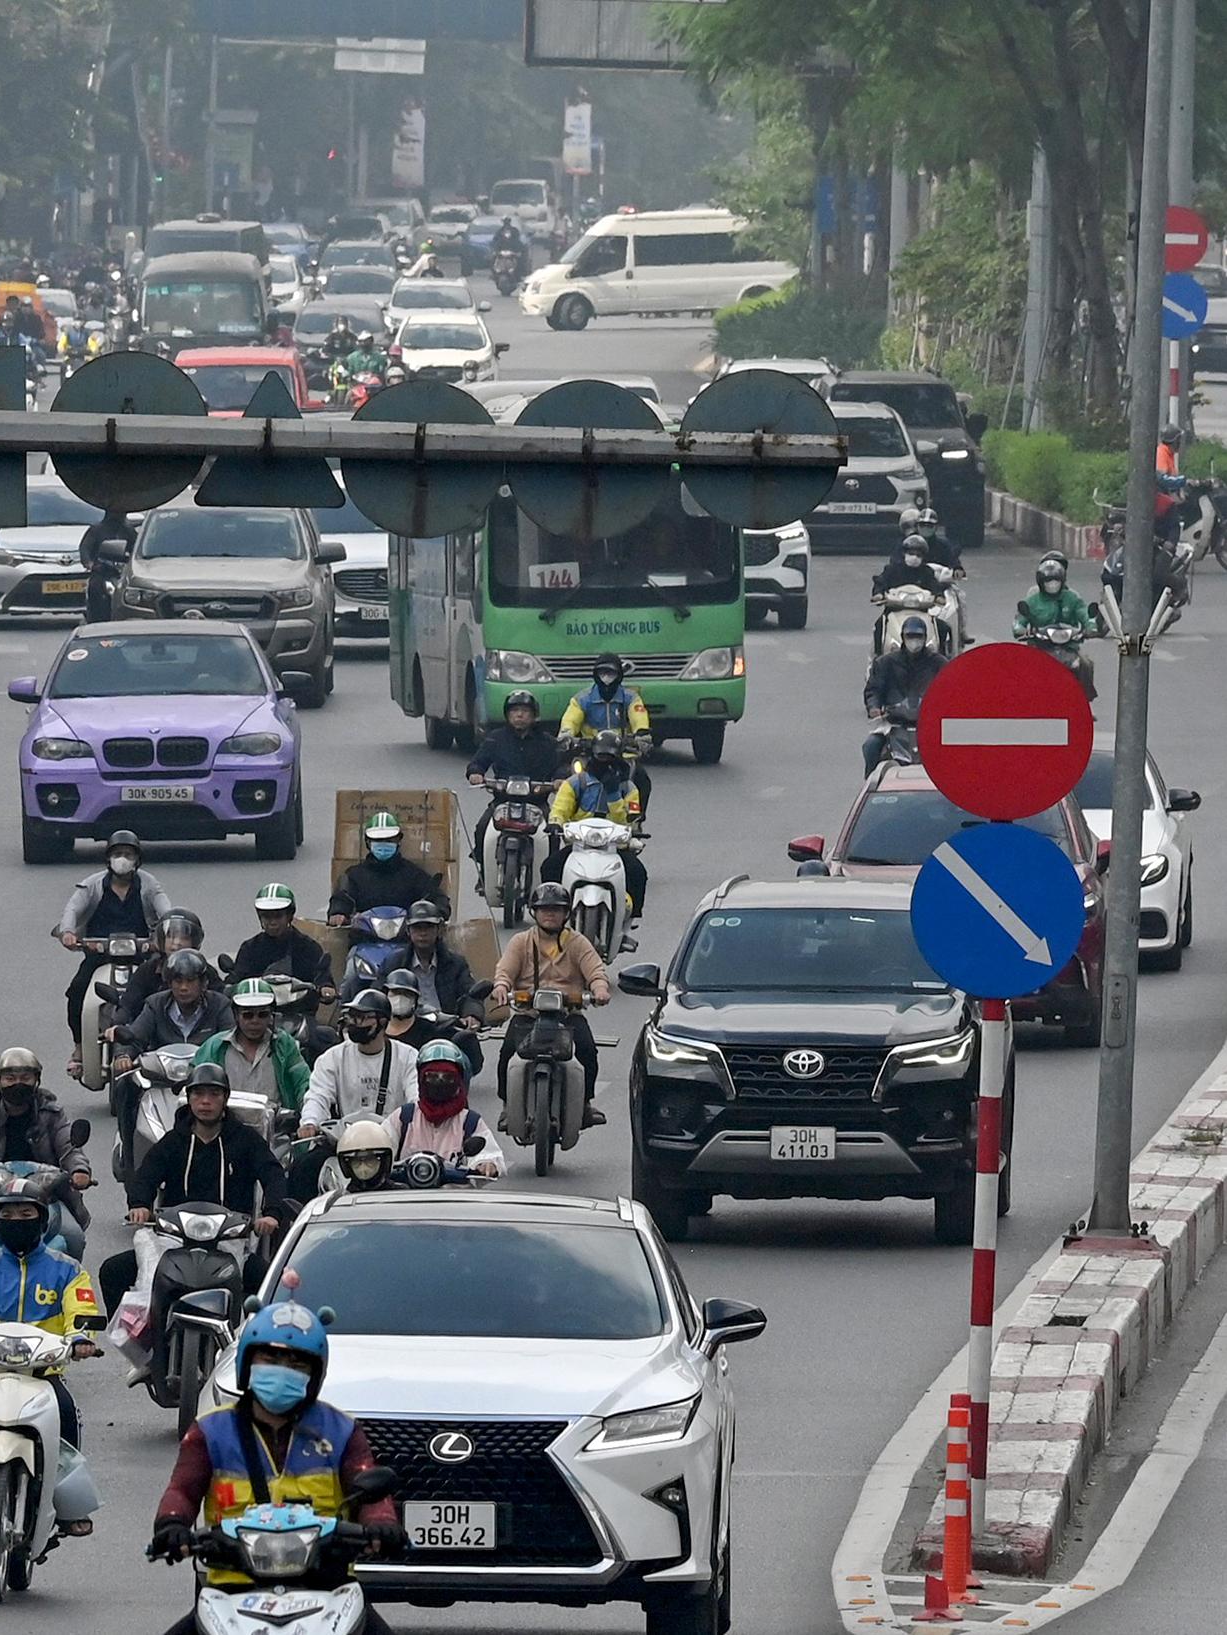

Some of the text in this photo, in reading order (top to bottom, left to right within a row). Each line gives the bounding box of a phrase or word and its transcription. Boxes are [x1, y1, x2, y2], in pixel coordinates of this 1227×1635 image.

[537, 569, 574, 588] 144
[639, 620, 661, 634] BUS
[790, 1129, 817, 1143] 30H
[778, 1144, 828, 1158] 411.03
[35, 1283, 58, 1305] be
[431, 1505, 470, 1524] 30H
[414, 1527, 486, 1546] 366.42
